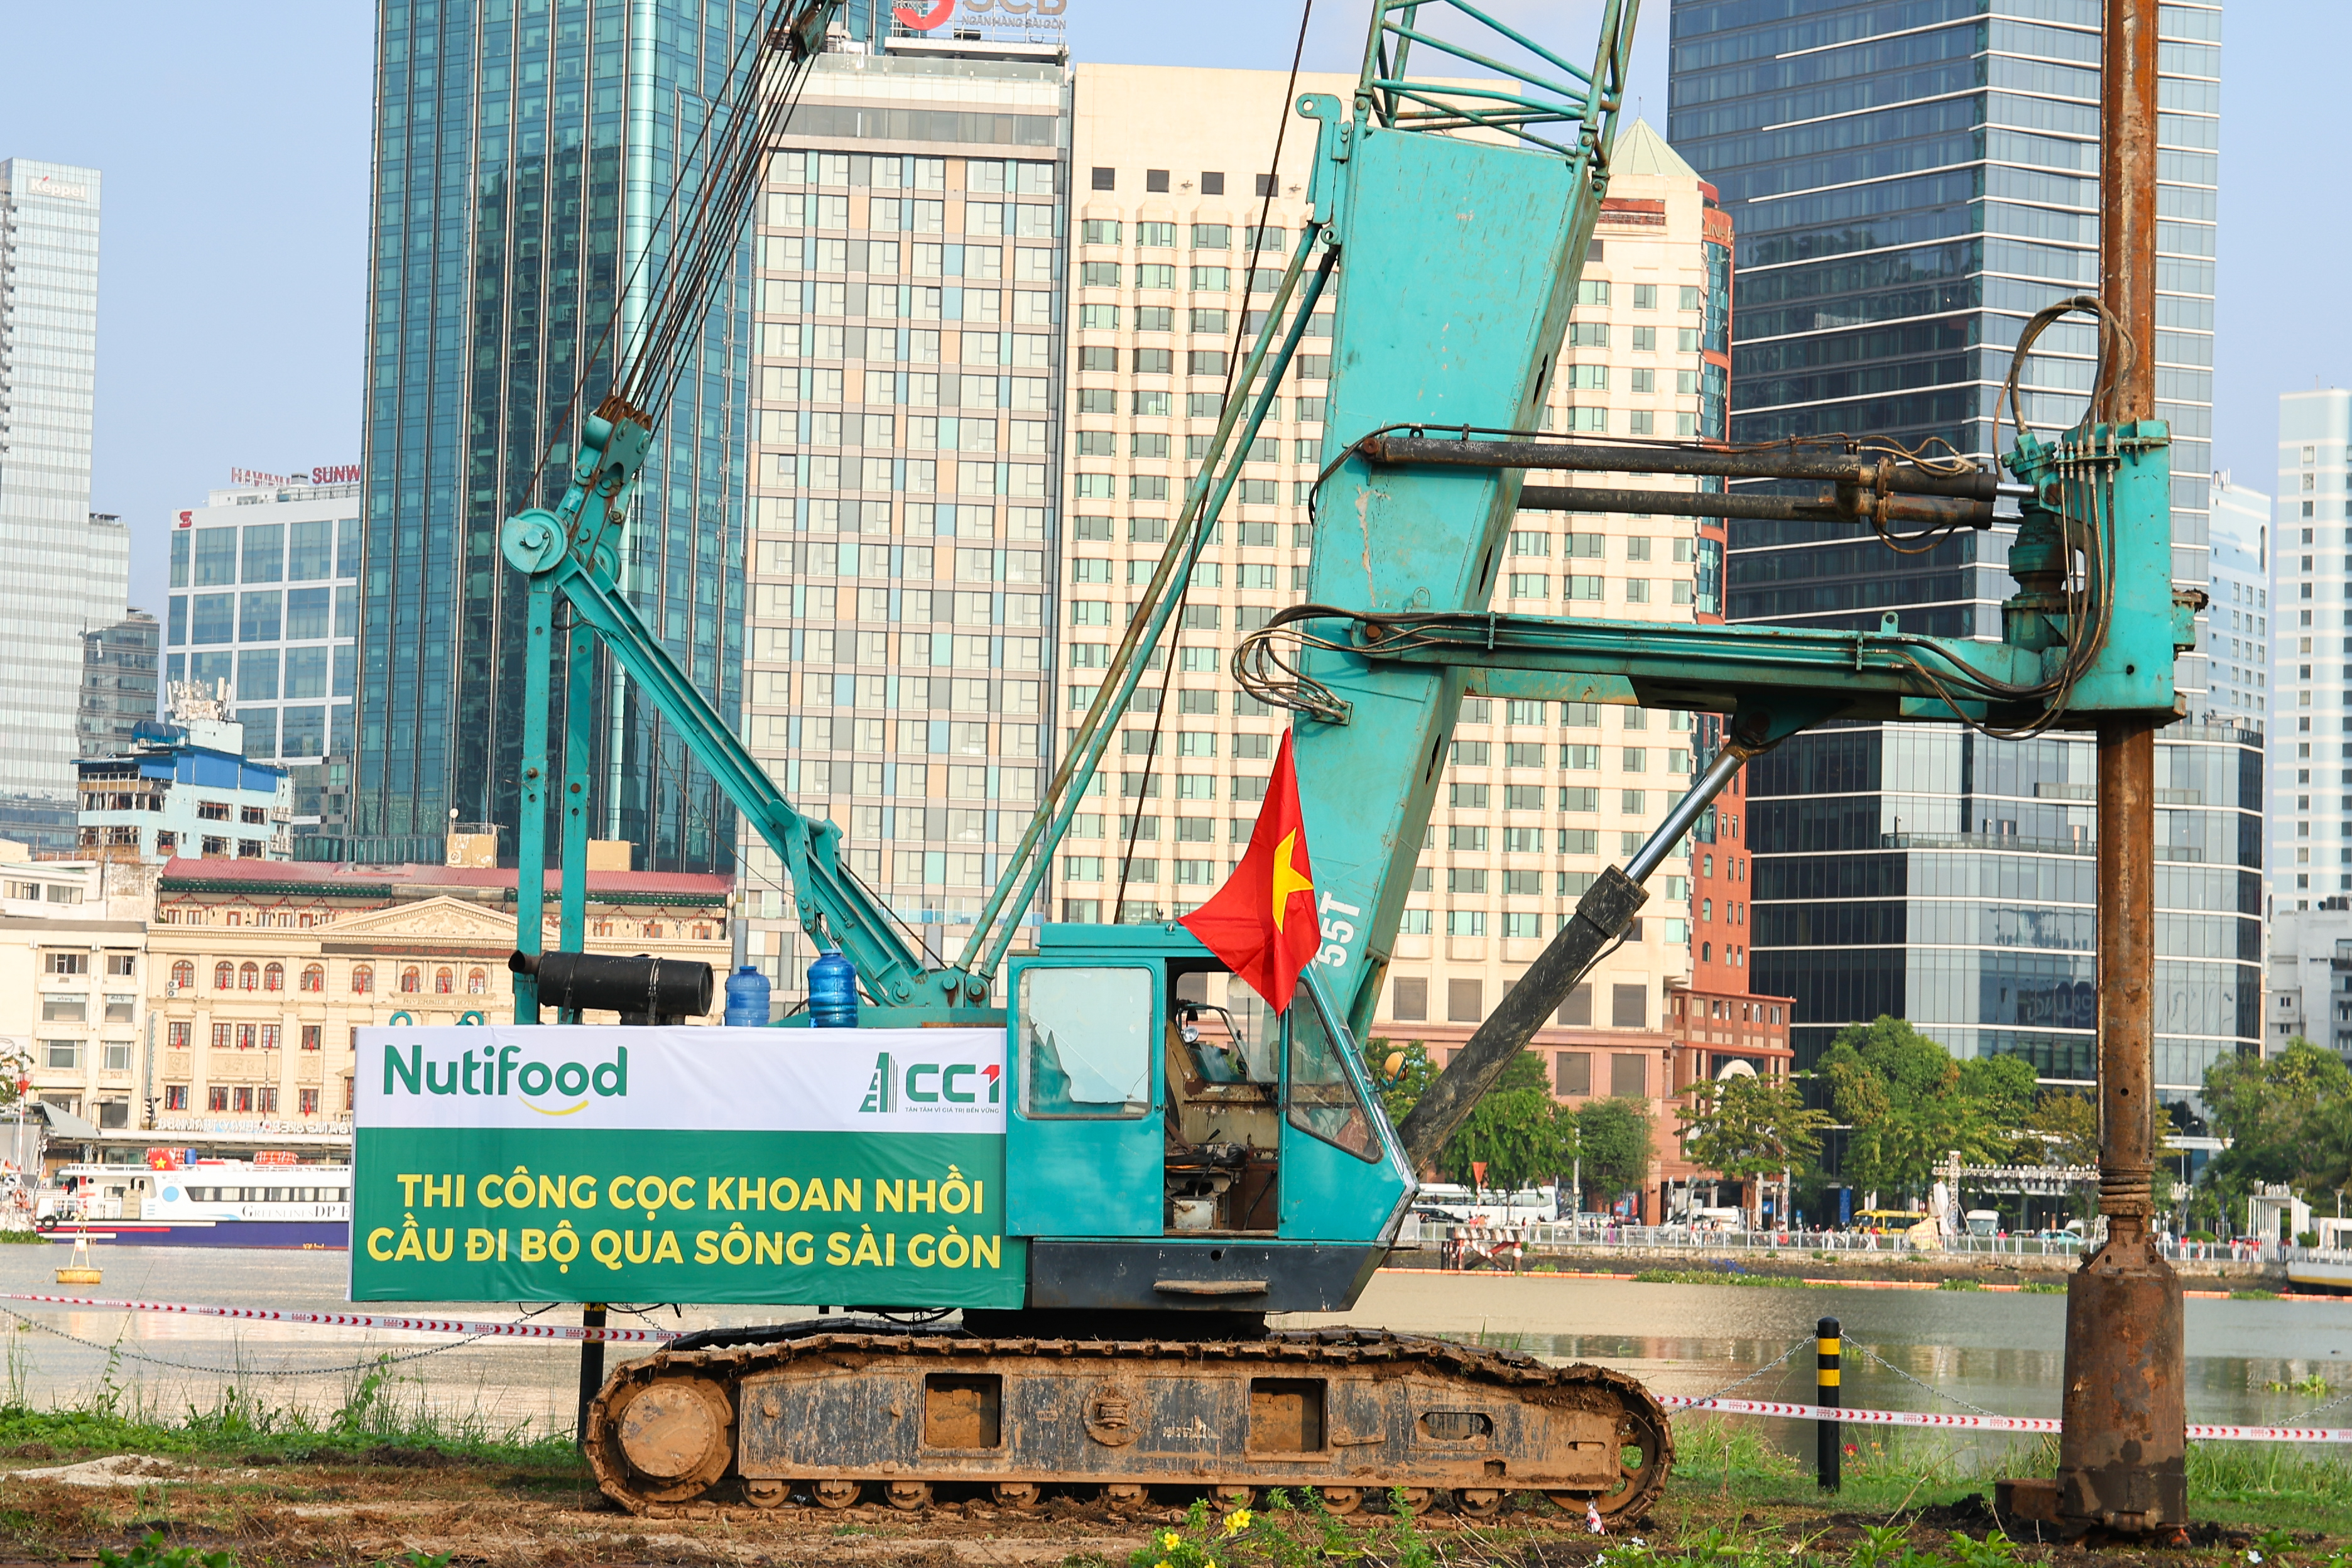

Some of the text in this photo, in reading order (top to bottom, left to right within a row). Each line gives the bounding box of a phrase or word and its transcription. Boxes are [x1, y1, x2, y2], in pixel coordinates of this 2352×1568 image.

[30, 176, 85, 198] Keppel
[1315, 891, 1360, 967] 55T
[384, 1045, 628, 1097] Nutifood
[906, 1064, 1000, 1103] CC1
[398, 1164, 984, 1221] THI CÔNG CỌC KHOAN NHỒI
[367, 1212, 1001, 1274] CẦU ĐI BỘ QUA SÔNG SÀI GÒN
